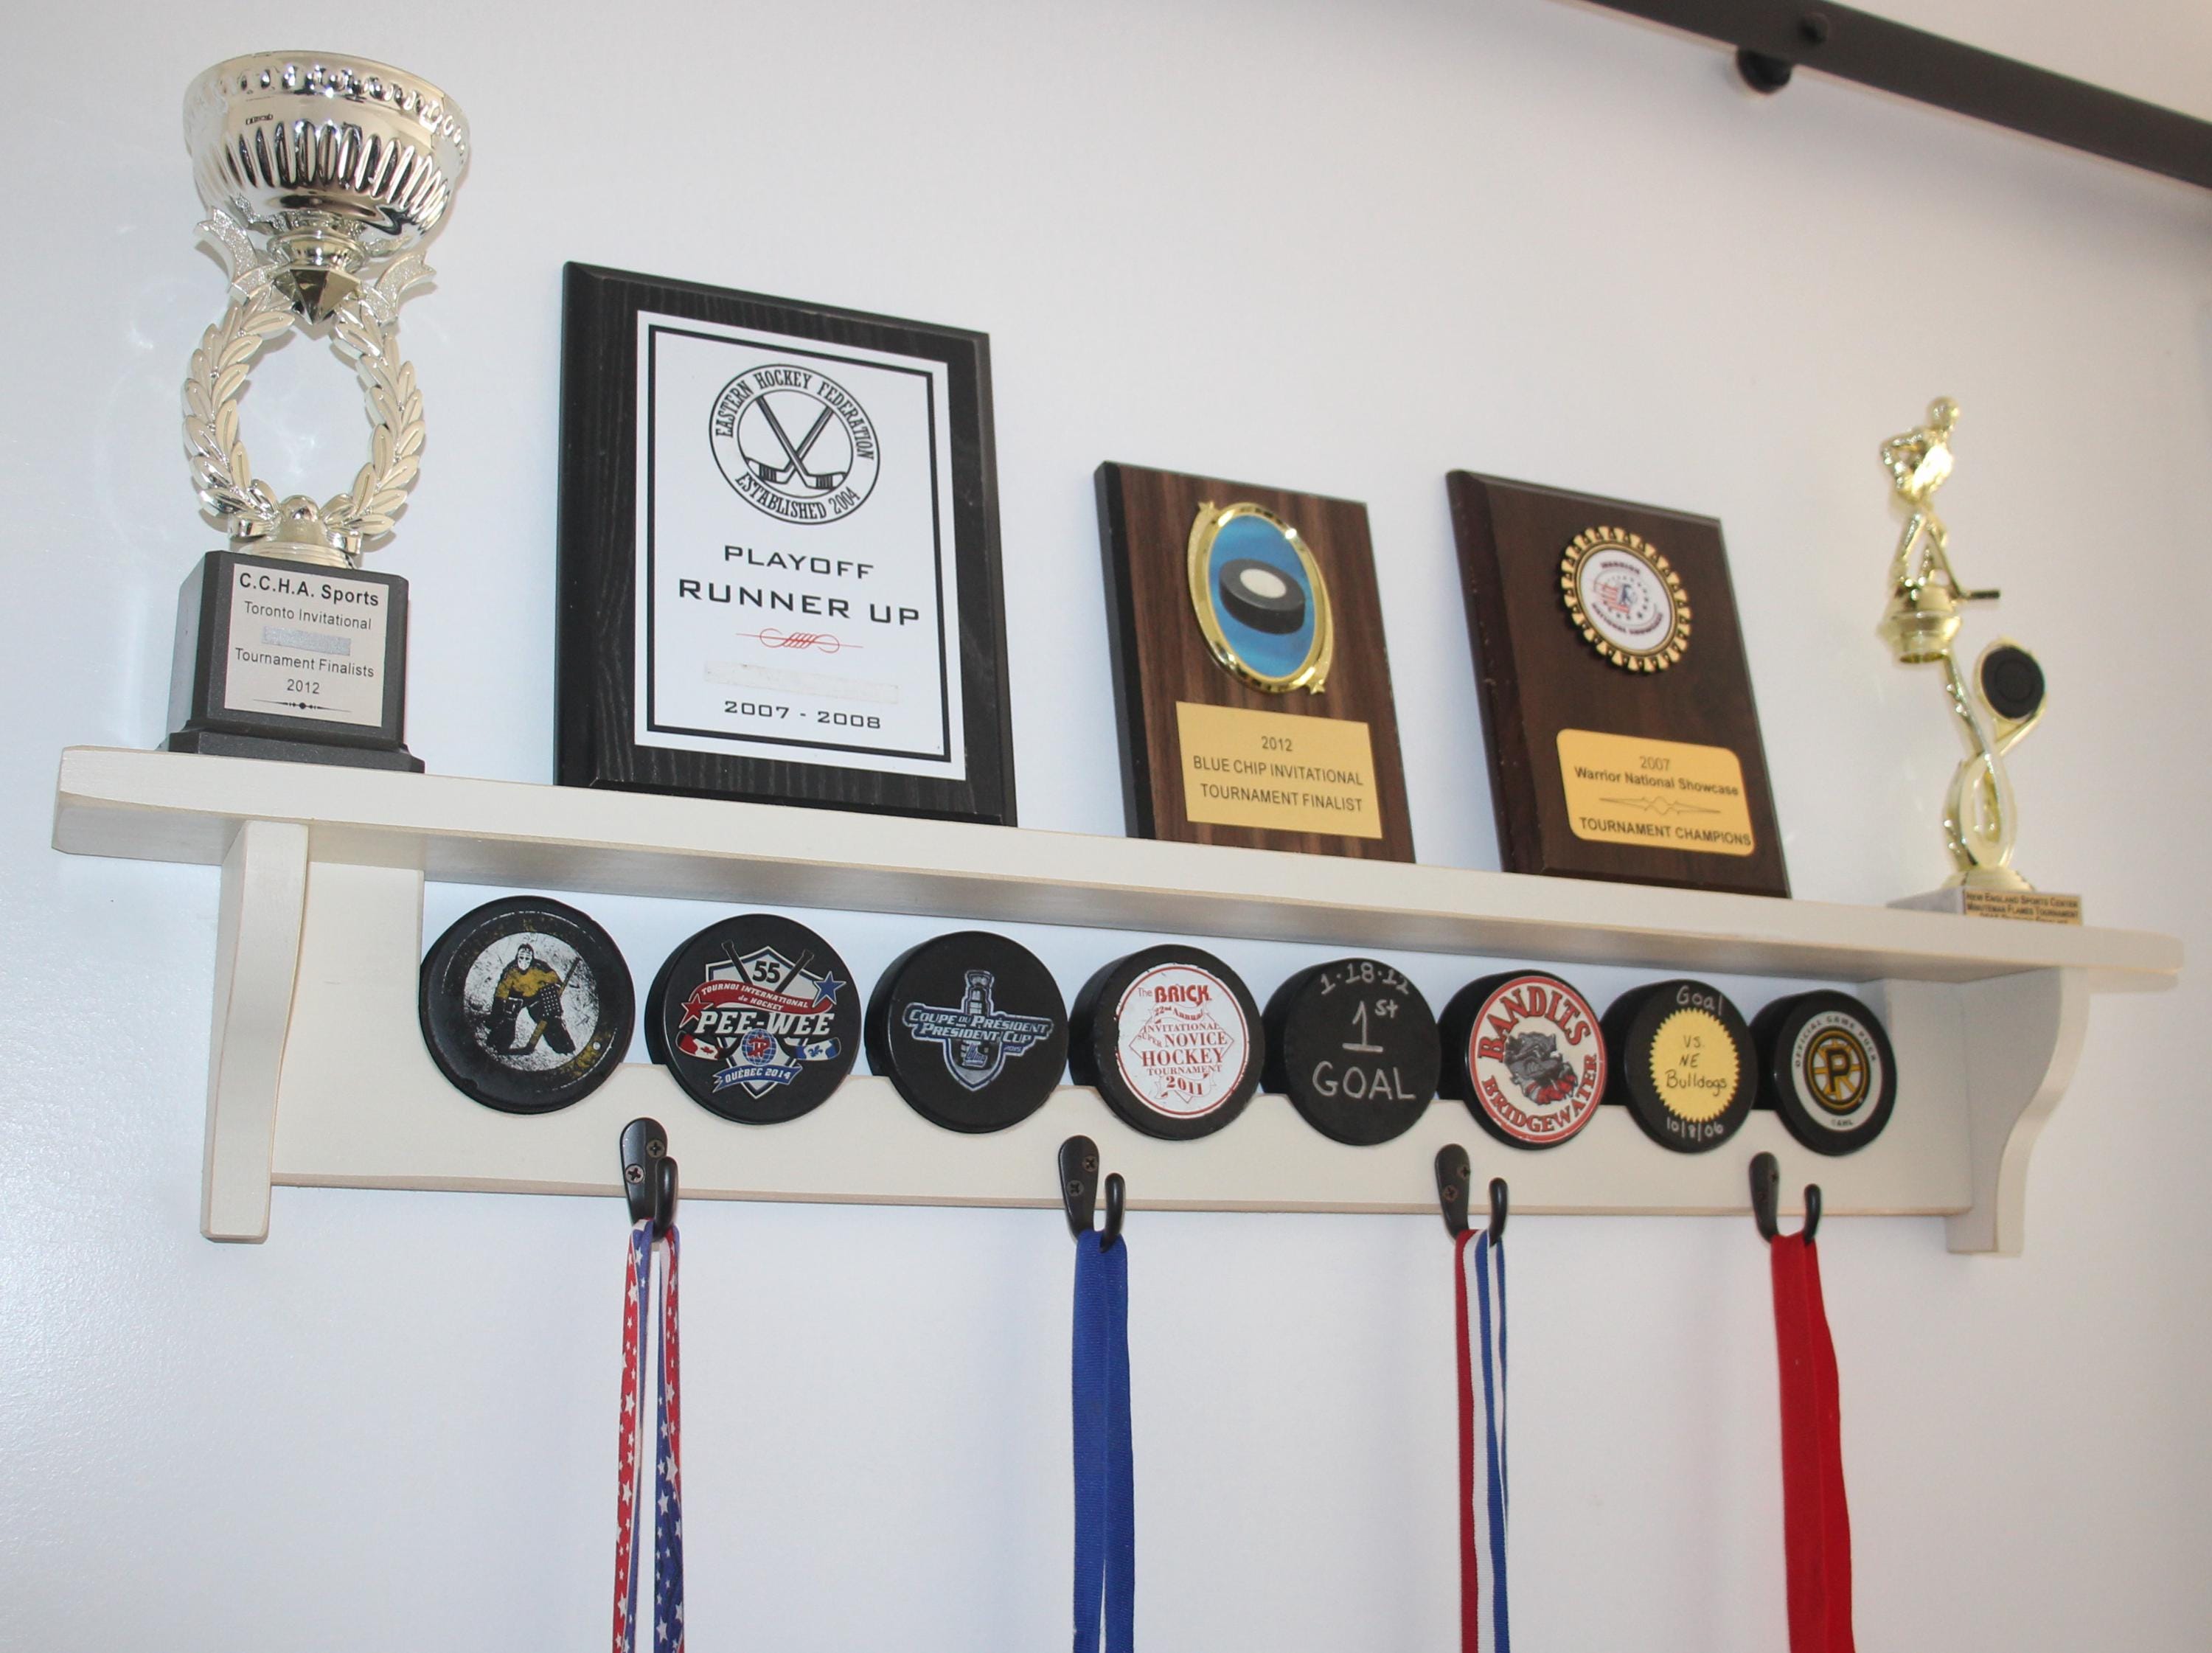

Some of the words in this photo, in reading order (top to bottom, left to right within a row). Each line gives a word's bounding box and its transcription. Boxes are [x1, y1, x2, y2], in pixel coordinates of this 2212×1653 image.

[715, 380, 754, 438] EASTERN
[754, 369, 813, 389] HOCKEY
[817, 381, 874, 460] FEDERATION
[735, 472, 827, 519] ESTABLISHED
[828, 486, 861, 515] 2004
[724, 545, 874, 580] PLAYOFF
[239, 572, 315, 598] C.C.H.A.
[321, 584, 380, 606] Sports
[678, 578, 851, 619] RUNNER
[869, 603, 919, 626] UP
[244, 600, 295, 620] Toronto
[299, 608, 372, 630] Invitational
[234, 647, 316, 671] Tournament
[319, 658, 375, 678] Finalists
[286, 678, 321, 695] 2012
[724, 700, 790, 720] 2007
[817, 711, 881, 729] 2008
[1262, 736, 1293, 752] 2012
[1193, 755, 1230, 773] BLUE
[1234, 759, 1267, 776] CHIP
[1270, 764, 1364, 786] INVITATIONAL
[1639, 756, 1671, 773] 2007
[1573, 766, 1621, 783] Warrior
[1624, 773, 1675, 788] National
[1678, 778, 1739, 796] Showcase
[1200, 783, 1298, 806] TOURNAMENT
[1303, 793, 1363, 812] FINALIST
[1579, 817, 1672, 838] TOURNAMENT
[1674, 826, 1752, 846] CHAMPIONS
[752, 960, 781, 984] 55
[701, 983, 740, 995] TOURNOI
[741, 985, 809, 1009] INTERNATIONAL
[749, 996, 785, 1011] HOCKEY
[1138, 987, 1152, 997] The
[1154, 984, 1210, 1006] BRICK
[1676, 984, 1723, 1017] Goal
[694, 1011, 835, 1036] PEE-WEE
[909, 1009, 957, 1025] COUPE
[1143, 1022, 1221, 1033] INVITATIONAL
[1173, 1007, 1204, 1021] Annual
[1478, 986, 1591, 1063] BANDITS
[919, 1023, 1000, 1040] PRESIDENT
[1002, 1030, 1032, 1043] CUP
[1138, 1033, 1162, 1048] SUPER
[1164, 1031, 1228, 1048] NOVICE
[1795, 1020, 1823, 1068] OFFICIAL
[1826, 1016, 1854, 1029] GAME
[1858, 1031, 1877, 1062] PUCK
[1141, 1047, 1225, 1067] HOCKEY
[1147, 1065, 1222, 1076] TOURNAMENT
[1678, 1054, 1700, 1068] NE
[765, 1068, 791, 1079] 2014
[1166, 1075, 1203, 1096] 2011
[1312, 1060, 1416, 1100] GOAL
[1665, 1069, 1728, 1097] Bulldogs
[1482, 1054, 1598, 1132] BRIDGEWATER
